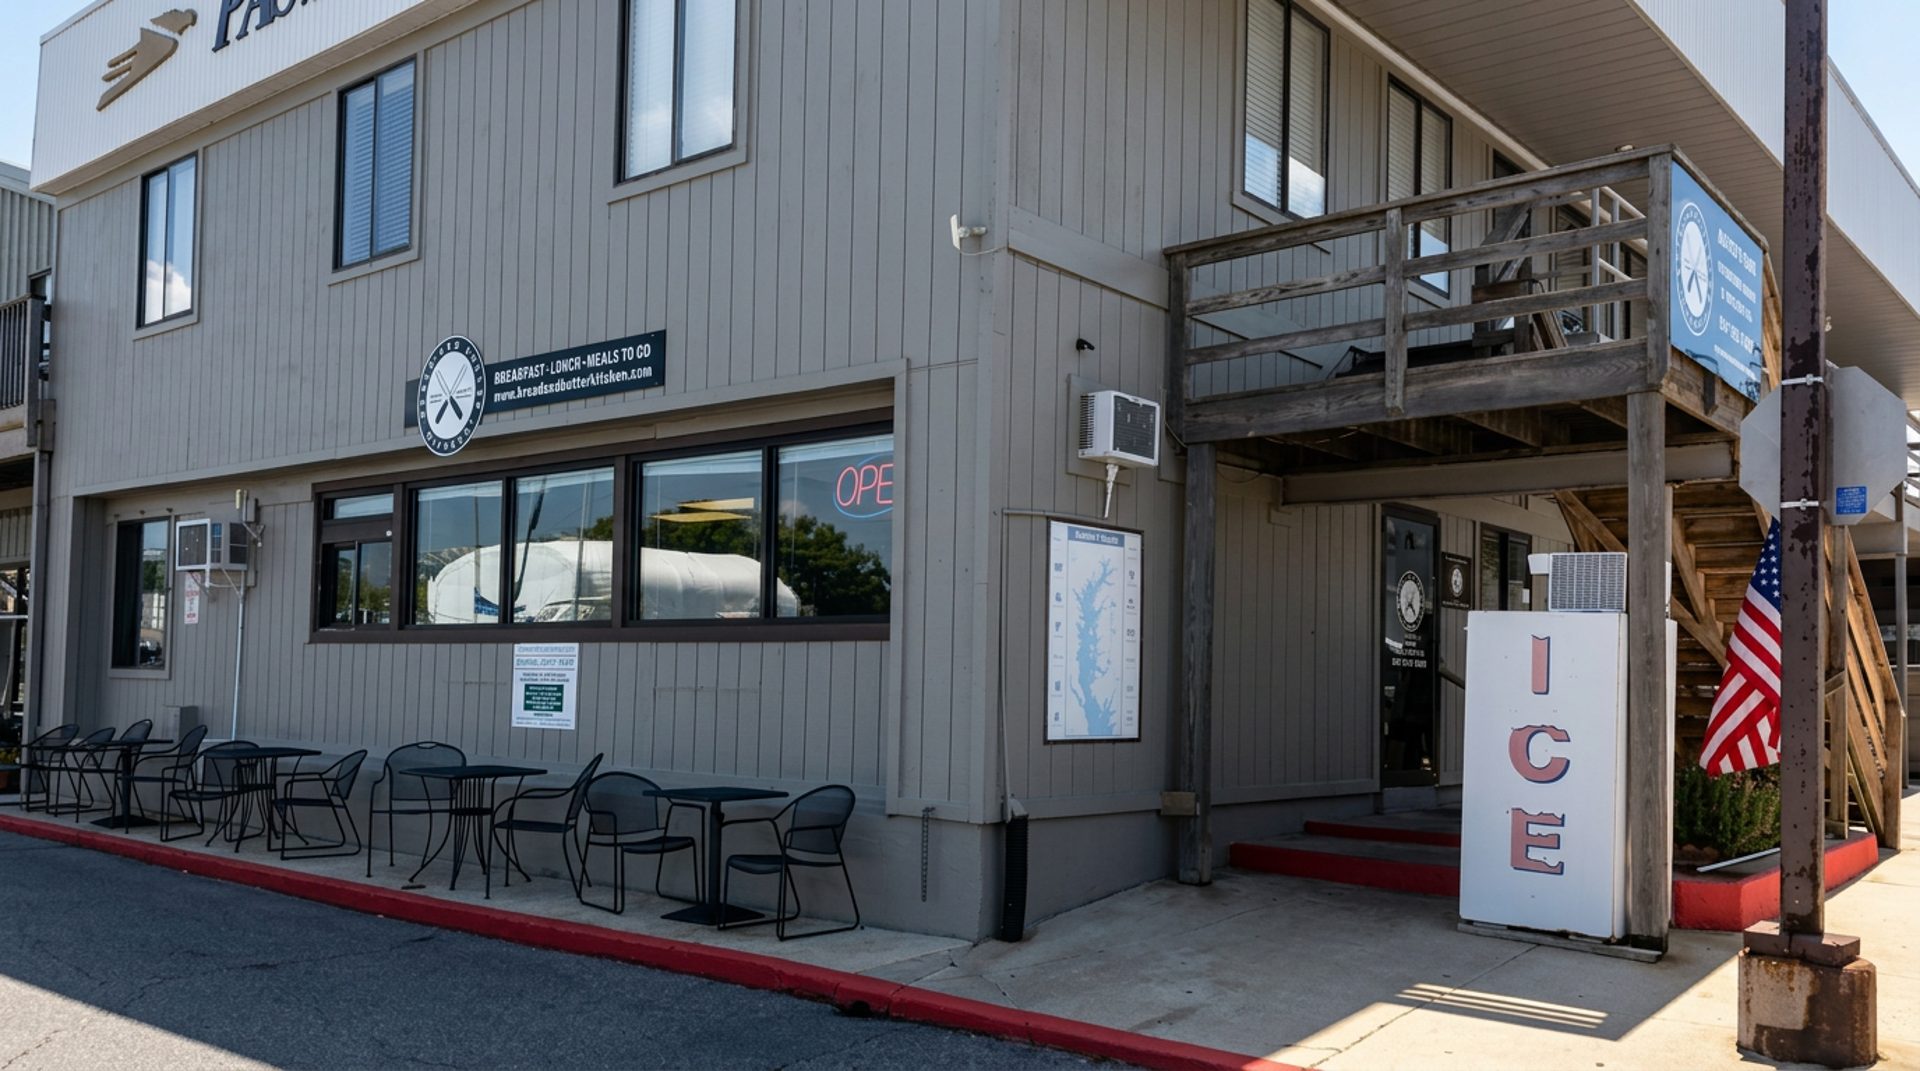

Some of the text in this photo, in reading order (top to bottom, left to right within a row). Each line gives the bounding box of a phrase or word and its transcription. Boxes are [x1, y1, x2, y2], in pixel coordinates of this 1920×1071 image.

[586, 349, 619, 369] MEALS
[620, 346, 635, 362] TO
[836, 463, 894, 507] OPE
[1508, 634, 1572, 876] ICE
